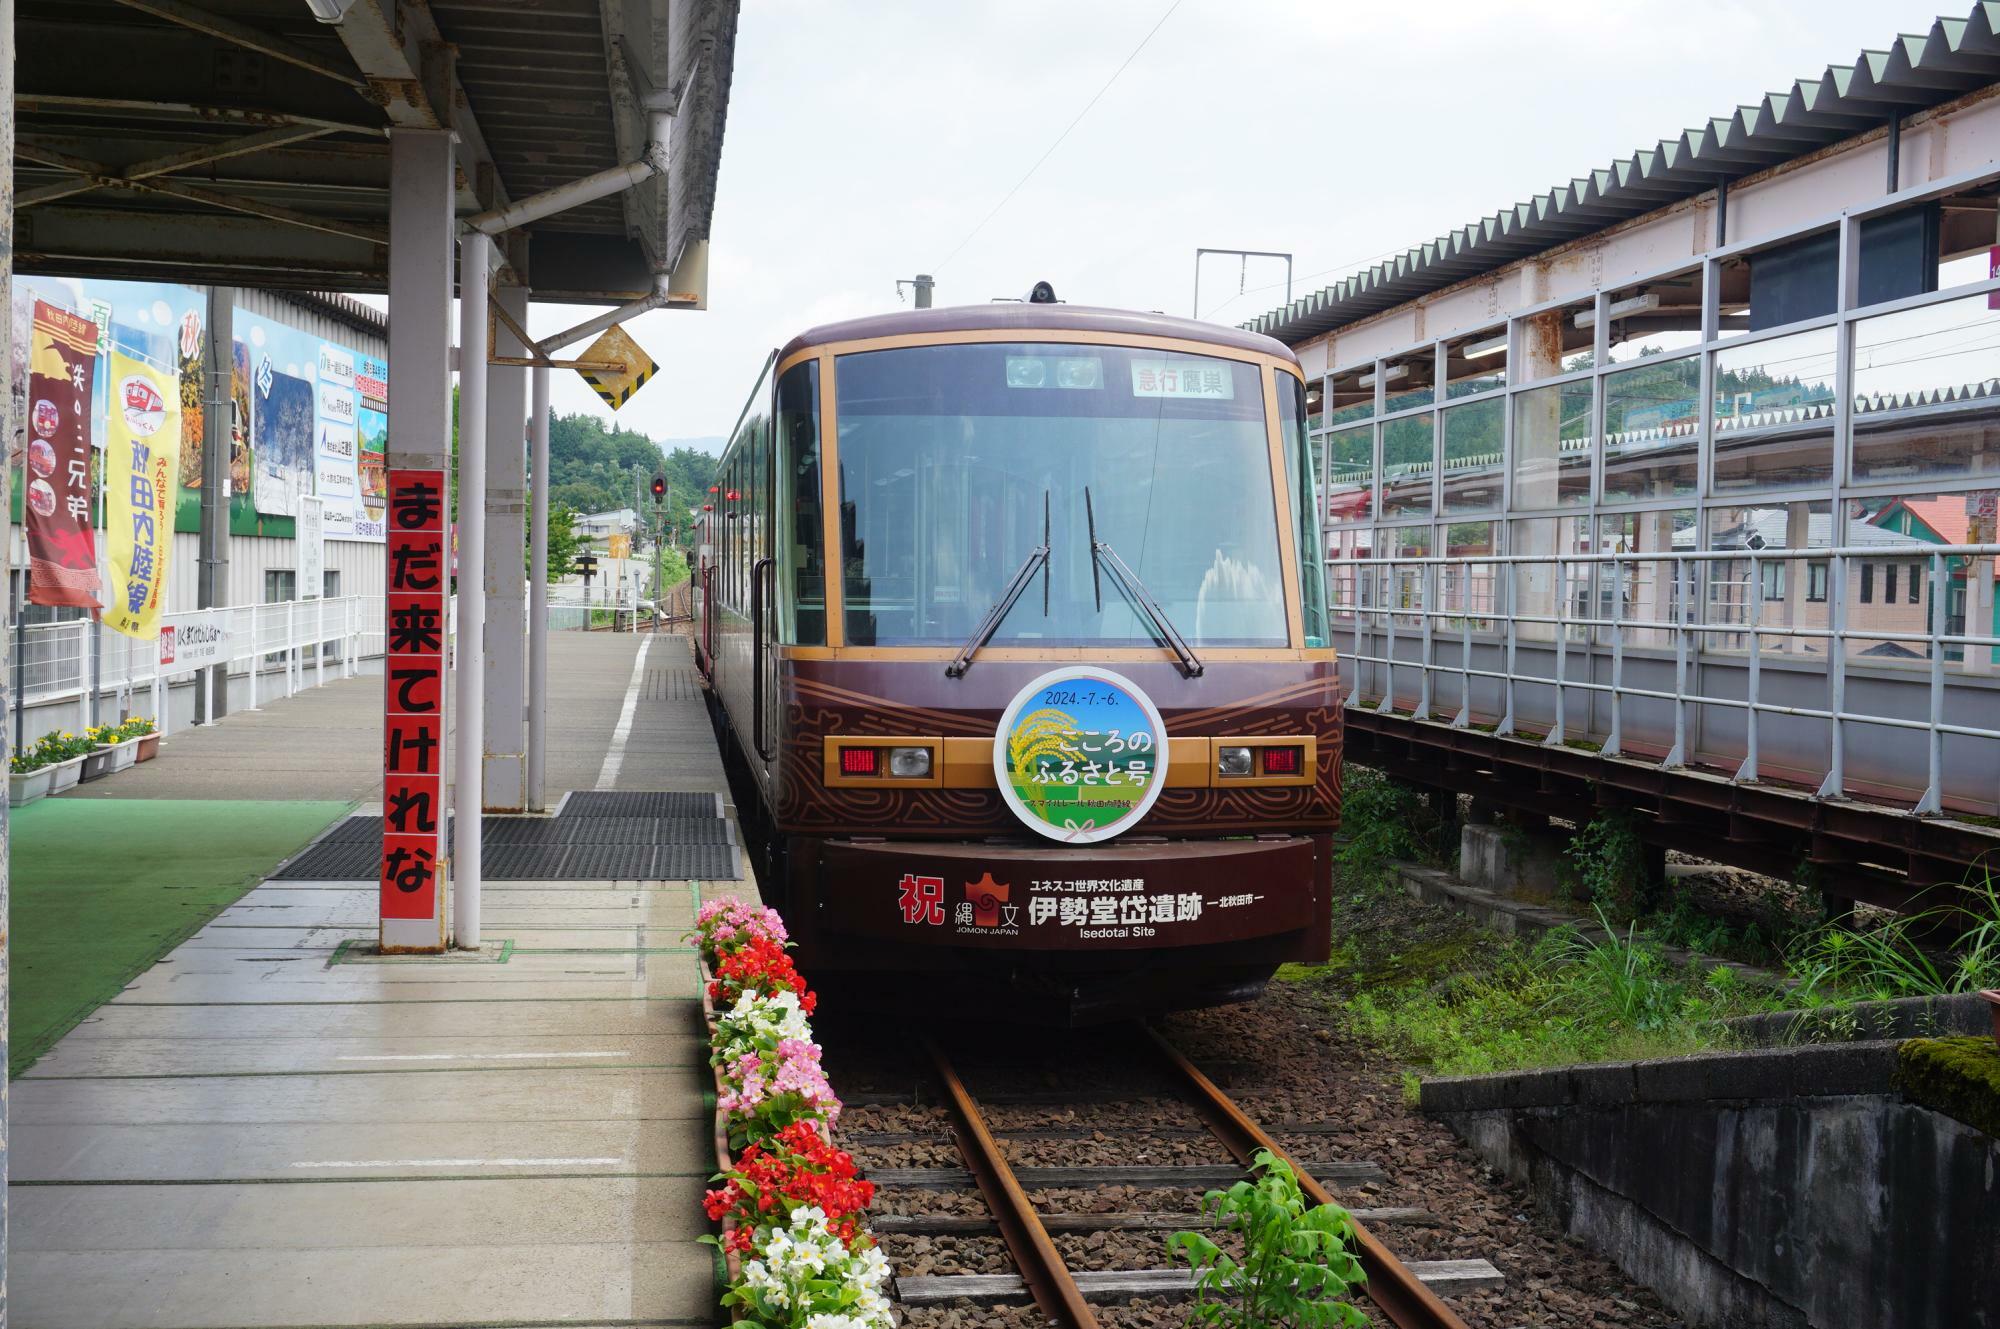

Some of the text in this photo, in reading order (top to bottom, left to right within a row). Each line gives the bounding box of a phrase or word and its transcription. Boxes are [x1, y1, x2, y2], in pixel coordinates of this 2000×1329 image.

[182, 313, 200, 354] 秋
[259, 356, 271, 395] 冬
[1138, 368, 1224, 394] 急行 鷹巣
[127, 440, 154, 614] 秋田内陸線
[386, 482, 442, 893] まだ来てけれな
[1059, 729, 1152, 753] こころの
[1032, 760, 1150, 786] ふるさと号
[898, 873, 945, 926] 祝
[1030, 879, 1145, 893] ユネスコ世界文化遺産
[1028, 892, 1203, 926] 伊勢堂岱遺跡
[956, 927, 1018, 936] JOMON JAPAN
[1079, 926, 1156, 939] Isedotai Site
